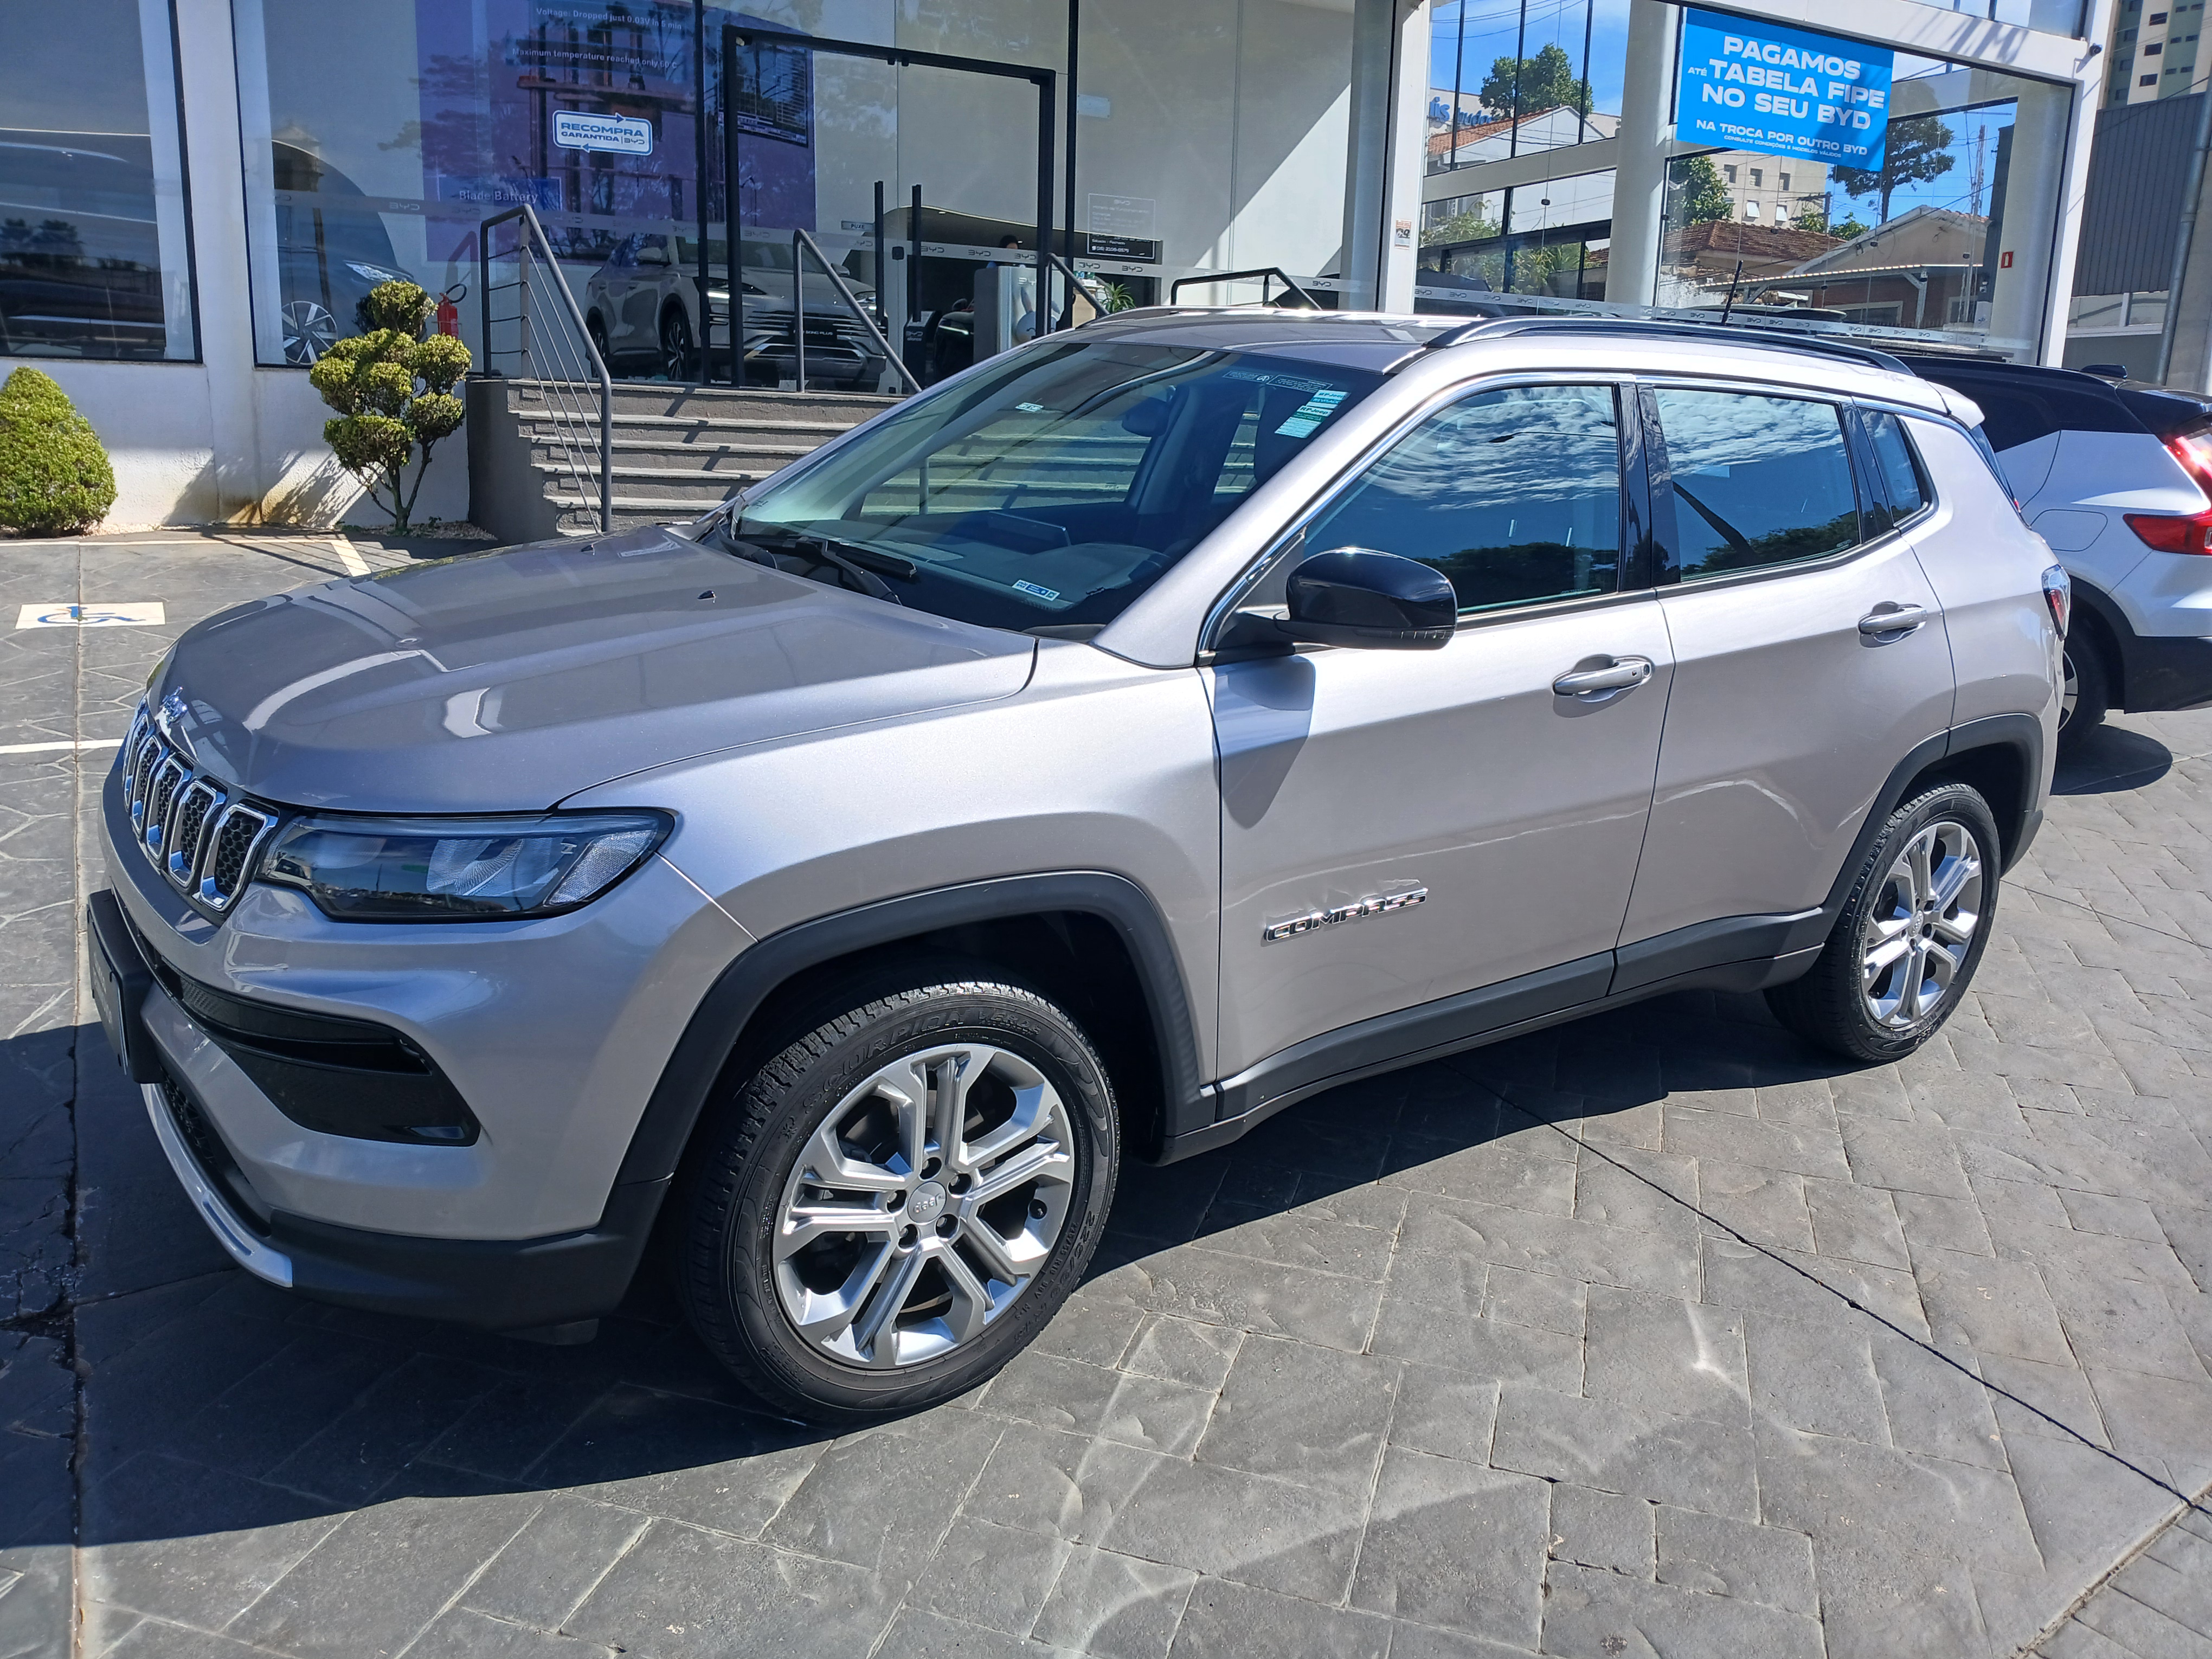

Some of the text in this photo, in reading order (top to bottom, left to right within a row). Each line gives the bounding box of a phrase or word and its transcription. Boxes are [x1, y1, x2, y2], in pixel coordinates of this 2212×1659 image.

[573, 10, 608, 20] Dropped
[609, 13, 625, 22] just
[554, 49, 605, 61] temperature
[607, 53, 640, 64] reached
[641, 58, 658, 68] only
[1724, 35, 1861, 80] PAGAMOS
[1687, 67, 1707, 76] ATÉ
[1709, 58, 1885, 109] TABELA FIPE
[1702, 83, 1870, 130] NO SEU BYD
[561, 122, 644, 137] RECOMPRA
[561, 131, 619, 142] GARANTIDA
[1696, 119, 1867, 156] NA TROCA POR OUTRO BYD
[1724, 135, 1753, 144] CONSULTE
[1754, 140, 1786, 149] CONDIÇÕES
[1792, 146, 1818, 154] MODELOS
[1819, 149, 1842, 158] VÁLIDOS
[460, 190, 538, 203] Blade Battery
[389, 202, 420, 211] BYD
[1019, 277, 1036, 285] BY
[1264, 888, 1429, 942] COMPASS
[802, 1009, 1043, 1115] SCORPION VERDE
